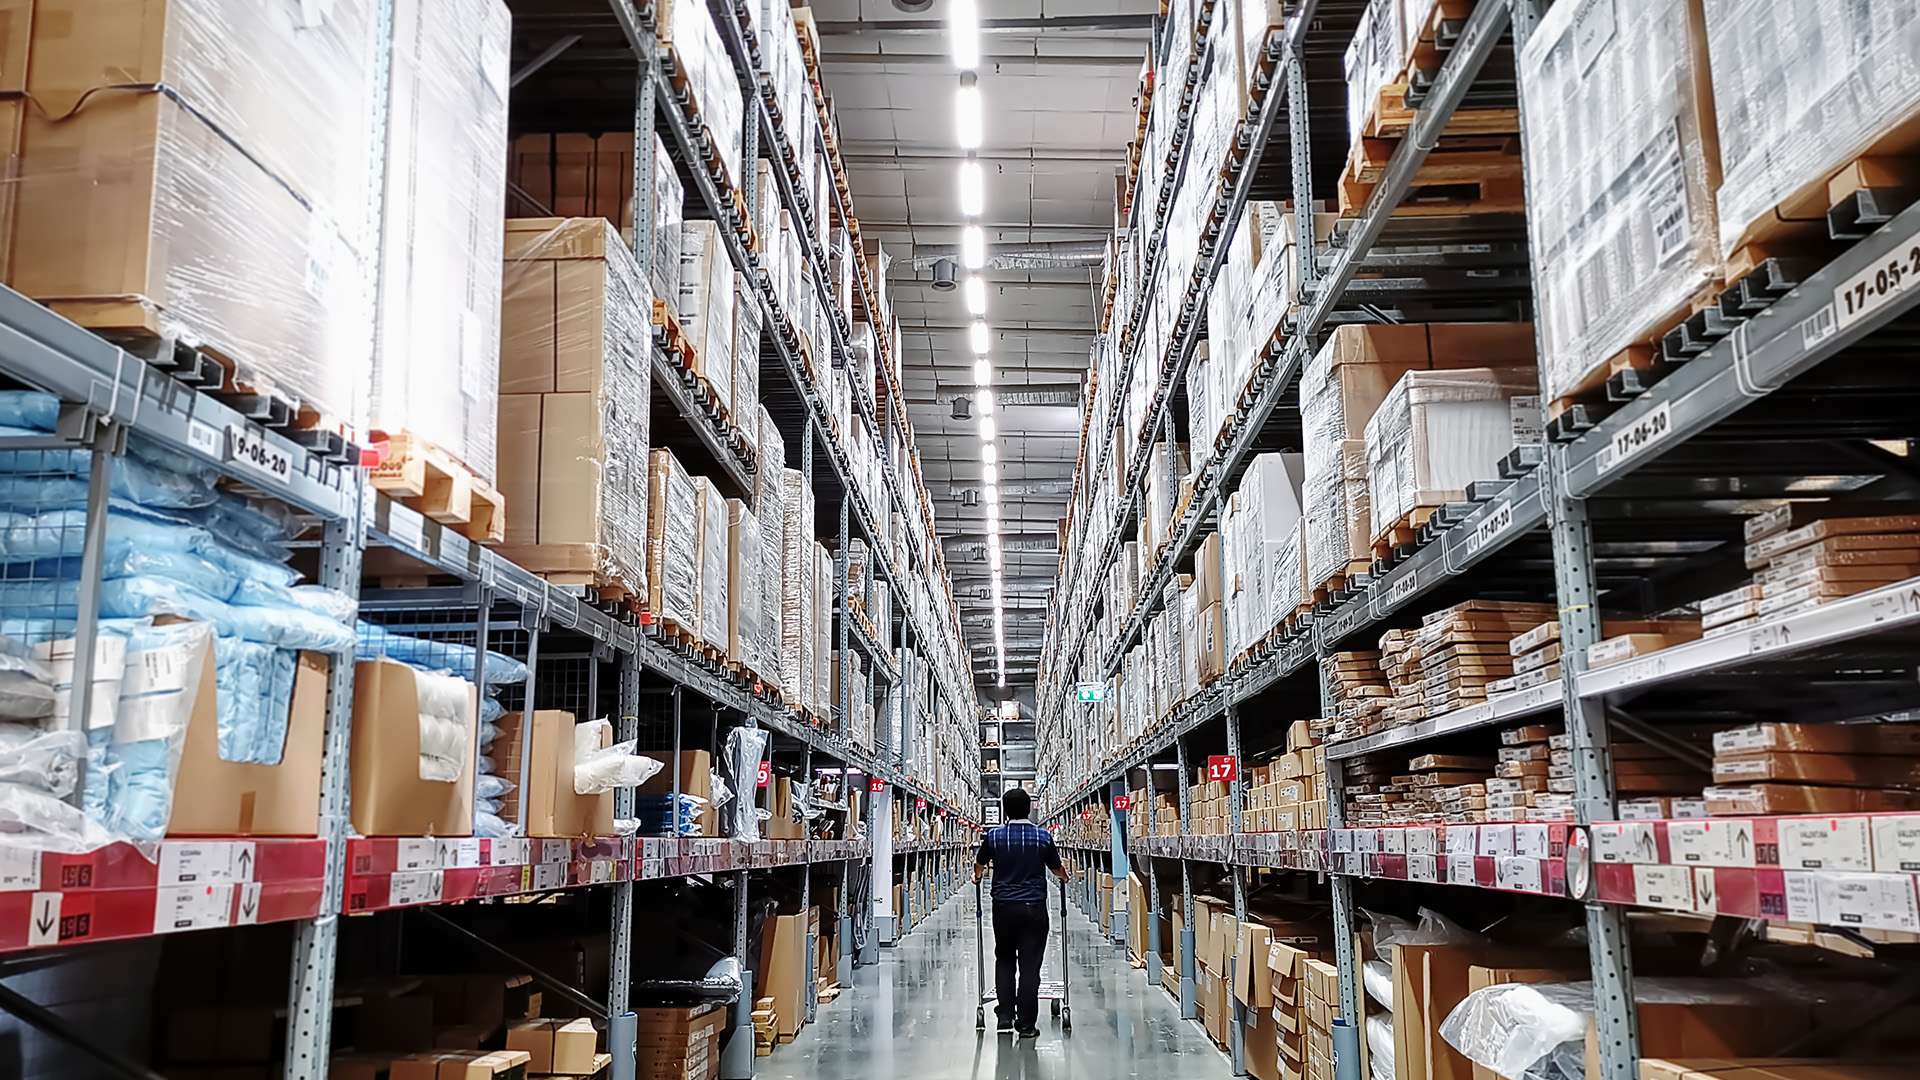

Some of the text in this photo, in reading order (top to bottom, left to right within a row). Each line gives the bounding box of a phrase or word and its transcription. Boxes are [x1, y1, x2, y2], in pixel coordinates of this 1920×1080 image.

[1617, 411, 1667, 455] 17-06-20
[1211, 764, 1231, 778] 17
[871, 782, 884, 791] 19
